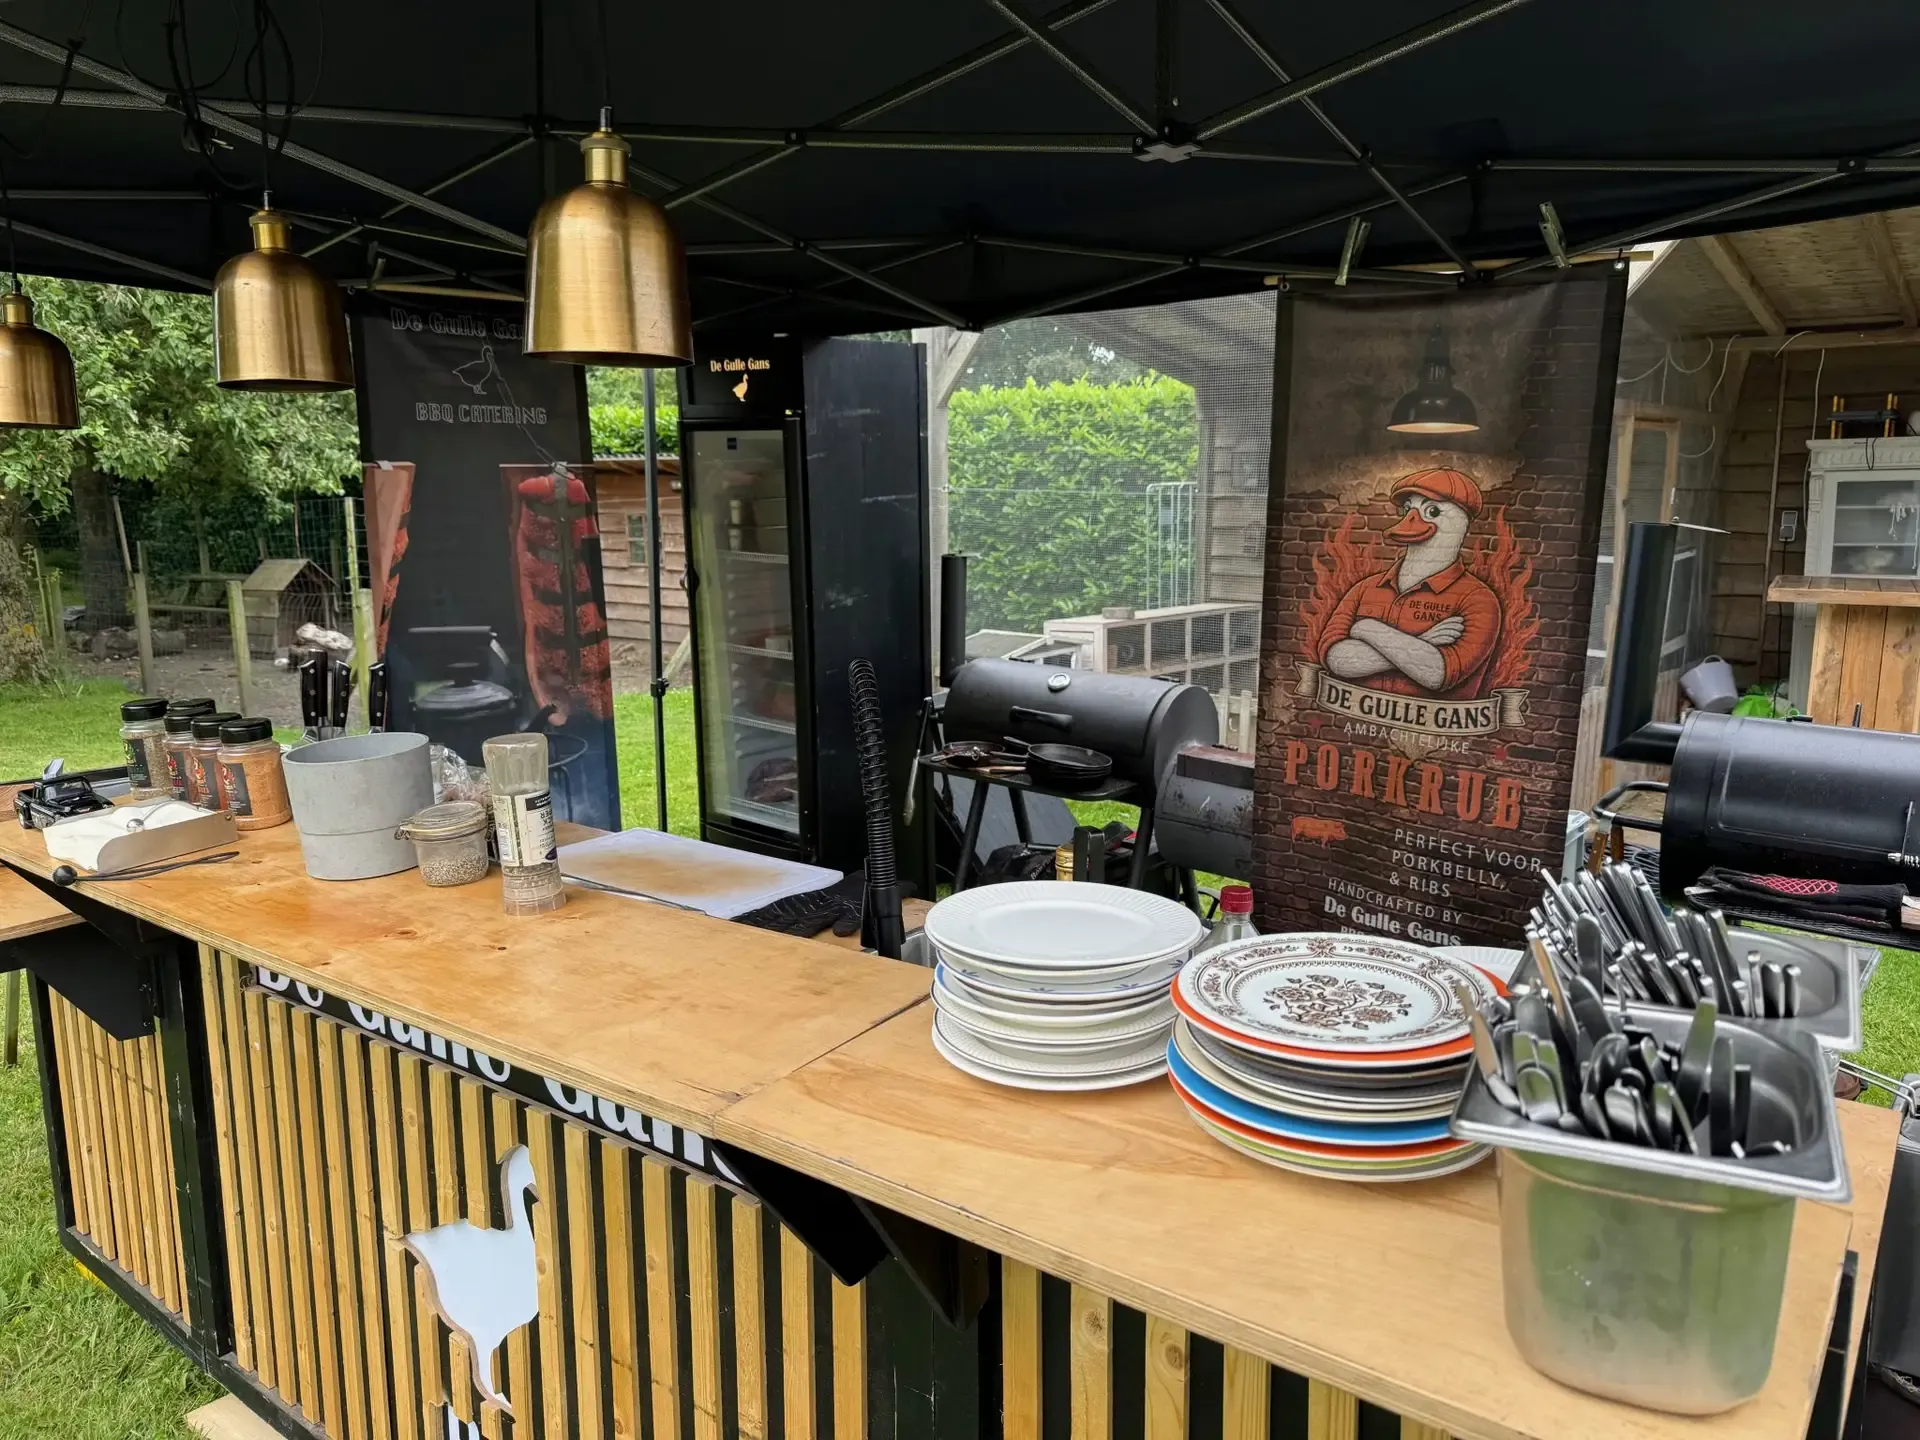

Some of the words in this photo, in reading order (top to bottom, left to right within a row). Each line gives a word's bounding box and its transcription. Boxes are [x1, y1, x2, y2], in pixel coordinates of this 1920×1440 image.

[390, 307, 423, 332] De
[429, 312, 487, 337] Gulle
[710, 360, 722, 372] De
[723, 358, 746, 371] Gulle
[747, 357, 770, 371] Gans
[415, 402, 453, 424] BBQ
[459, 403, 548, 424] CATERING
[1409, 600, 1421, 609] DE
[1423, 601, 1451, 612] GULLE
[1325, 684, 1351, 709] DE
[1358, 694, 1427, 726] GULLE
[1433, 706, 1492, 729] GANS
[1343, 721, 1470, 755] AMBACHTELIJKE
[1283, 740, 1523, 830] PORKRUB
[1394, 828, 1476, 859] PERFECT
[1484, 847, 1542, 873] VOOR
[1389, 871, 1400, 886] &
[1409, 875, 1451, 898] RIBS
[1392, 850, 1506, 890] PORKBELLY,
[1328, 878, 1436, 919] HANDCRAFTED
[1442, 909, 1463, 924] BY
[1324, 895, 1347, 918] De
[1351, 906, 1401, 934] Gulle
[1407, 921, 1462, 946] Gans
